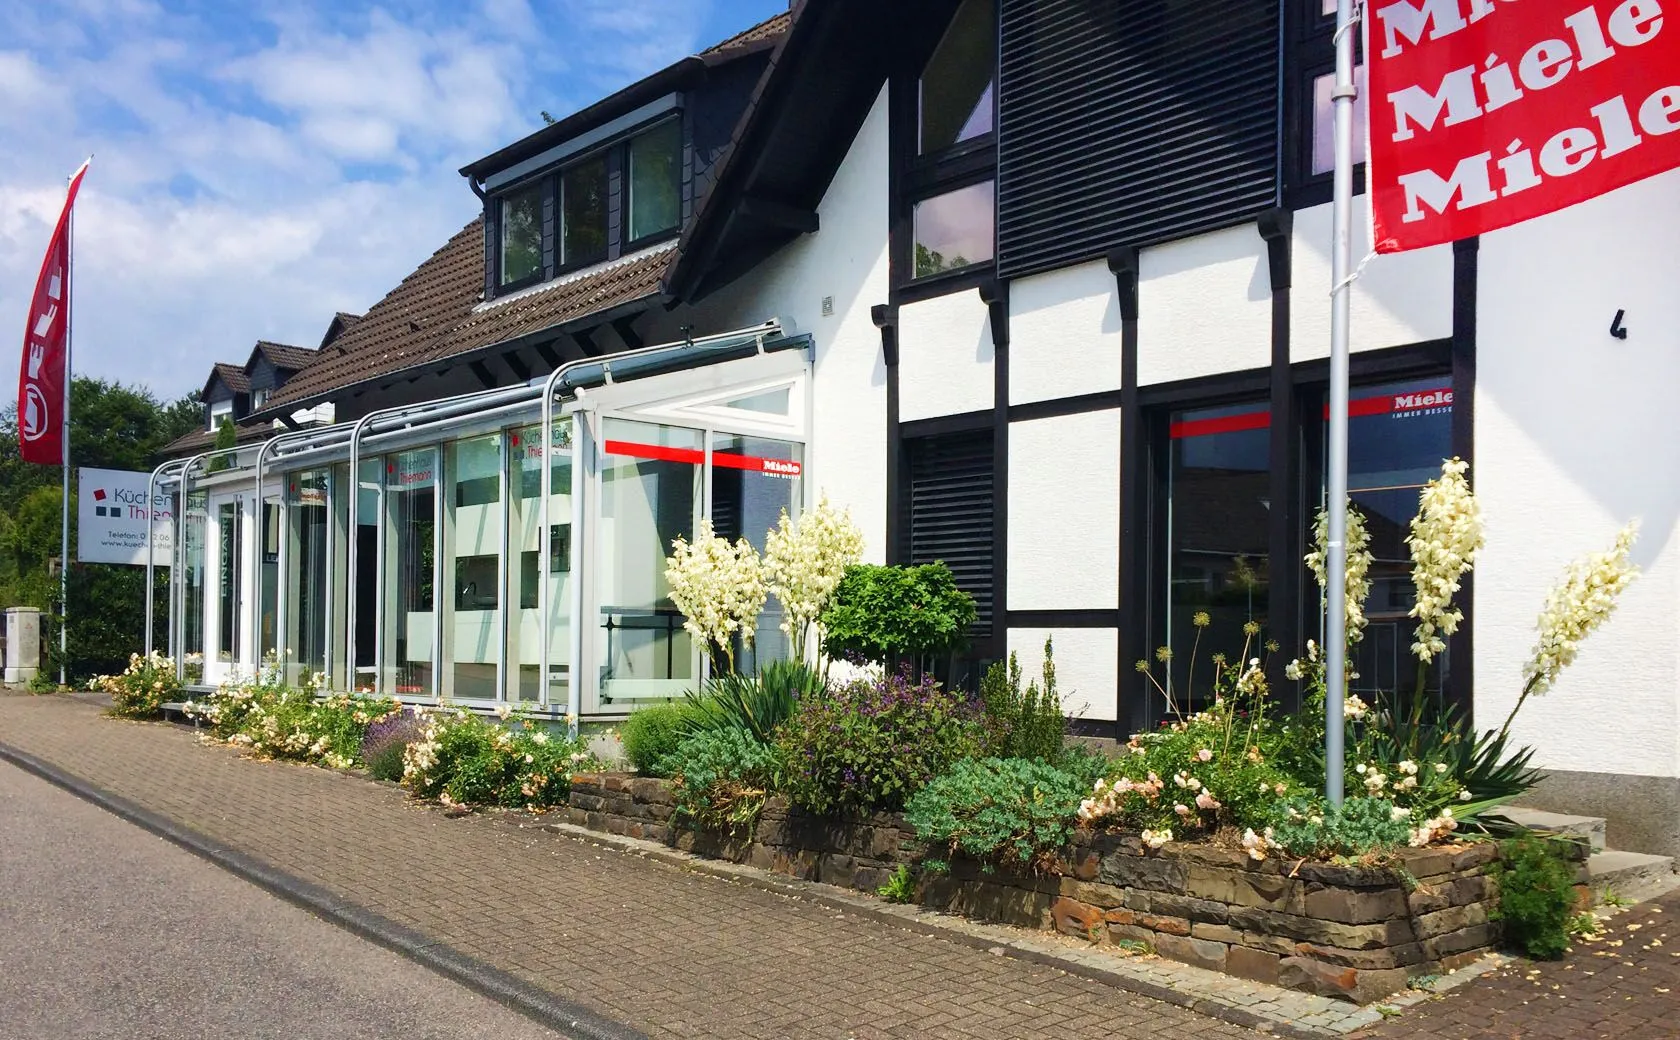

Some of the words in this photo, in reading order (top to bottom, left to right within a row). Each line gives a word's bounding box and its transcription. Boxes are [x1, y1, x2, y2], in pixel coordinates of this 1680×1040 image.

[1387, 0, 1664, 142] Miele
[1398, 85, 1680, 223] Miele
[1395, 391, 1453, 409] Miele
[1391, 410, 1421, 419] IMMER
[1425, 406, 1453, 416] BESSE
[763, 461, 800, 473] Miele
